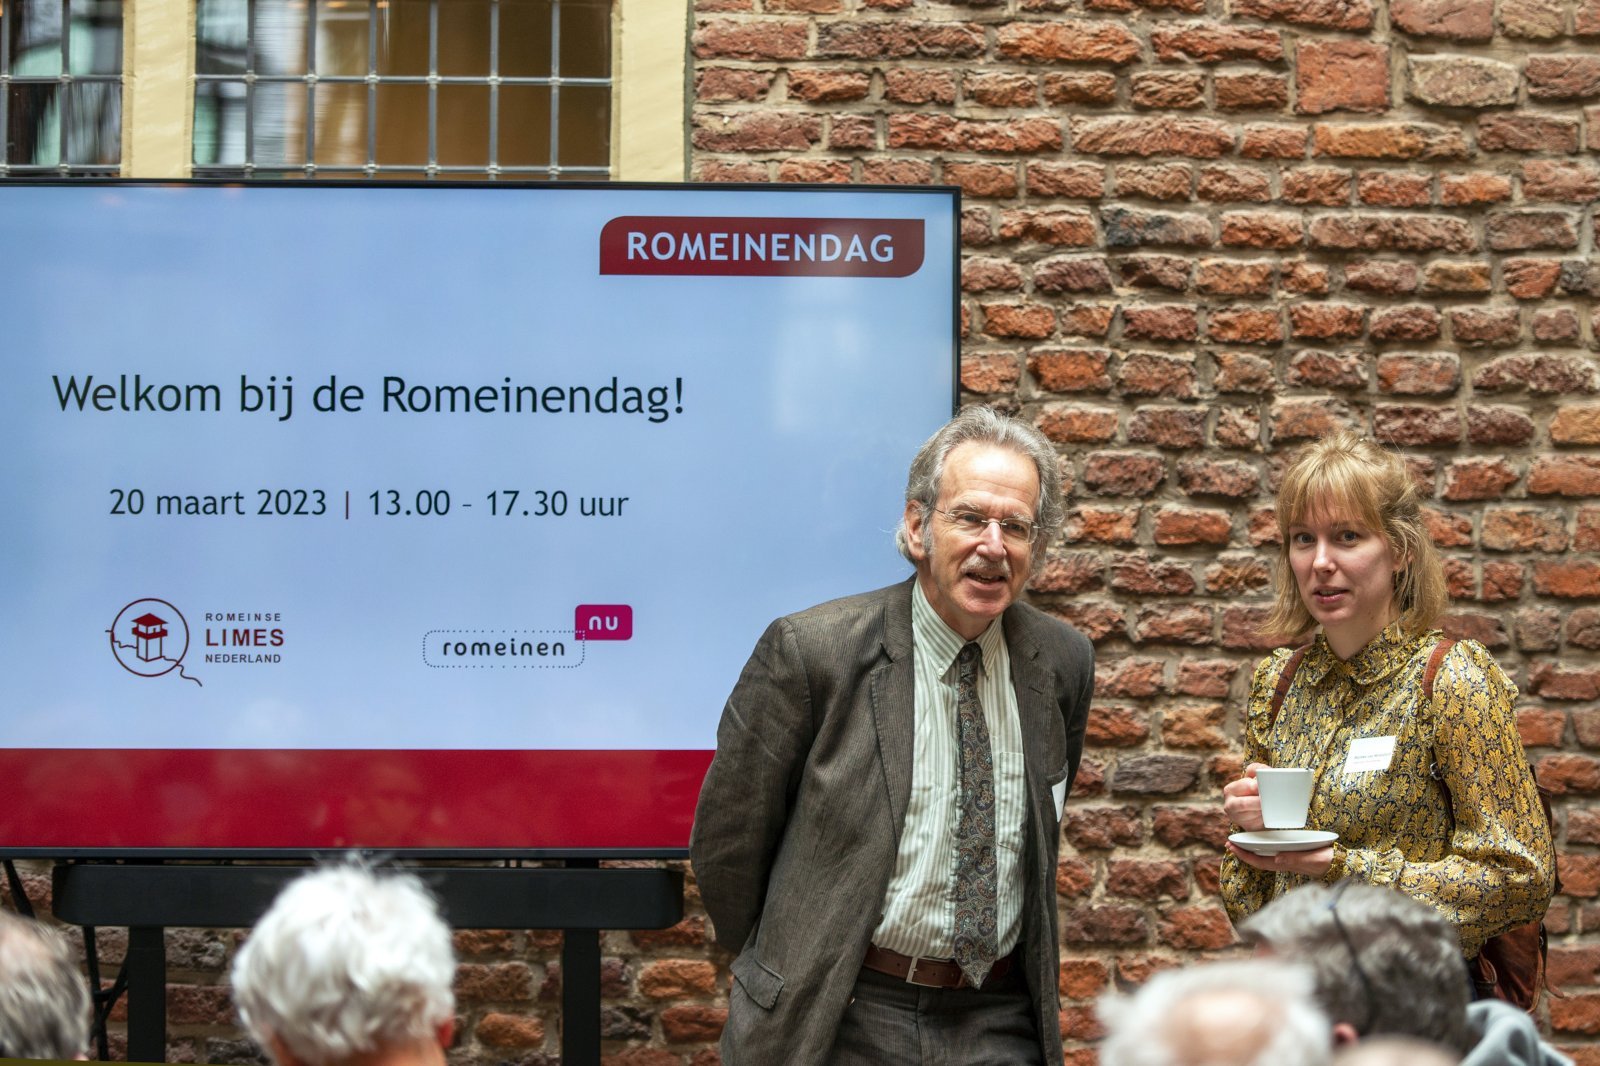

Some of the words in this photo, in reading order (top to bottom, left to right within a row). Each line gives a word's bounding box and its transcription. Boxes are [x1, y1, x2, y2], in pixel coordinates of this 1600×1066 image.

[627, 231, 895, 263] ROMEINENDAG
[52, 374, 220, 413] Welkom
[241, 375, 293, 421] bij
[313, 375, 365, 413] de
[383, 376, 684, 423] Romeinendag!
[110, 489, 145, 516] 20
[157, 490, 246, 516] maart
[257, 489, 327, 516] 2023
[369, 490, 450, 517] 13.00
[487, 490, 569, 517] 17.30
[580, 497, 630, 517] uur
[205, 612, 281, 622] ROMEINSE
[588, 615, 619, 632] nu
[205, 628, 284, 647] LIMES
[442, 637, 565, 657] romeinen
[205, 653, 281, 664] NEDERLAND
